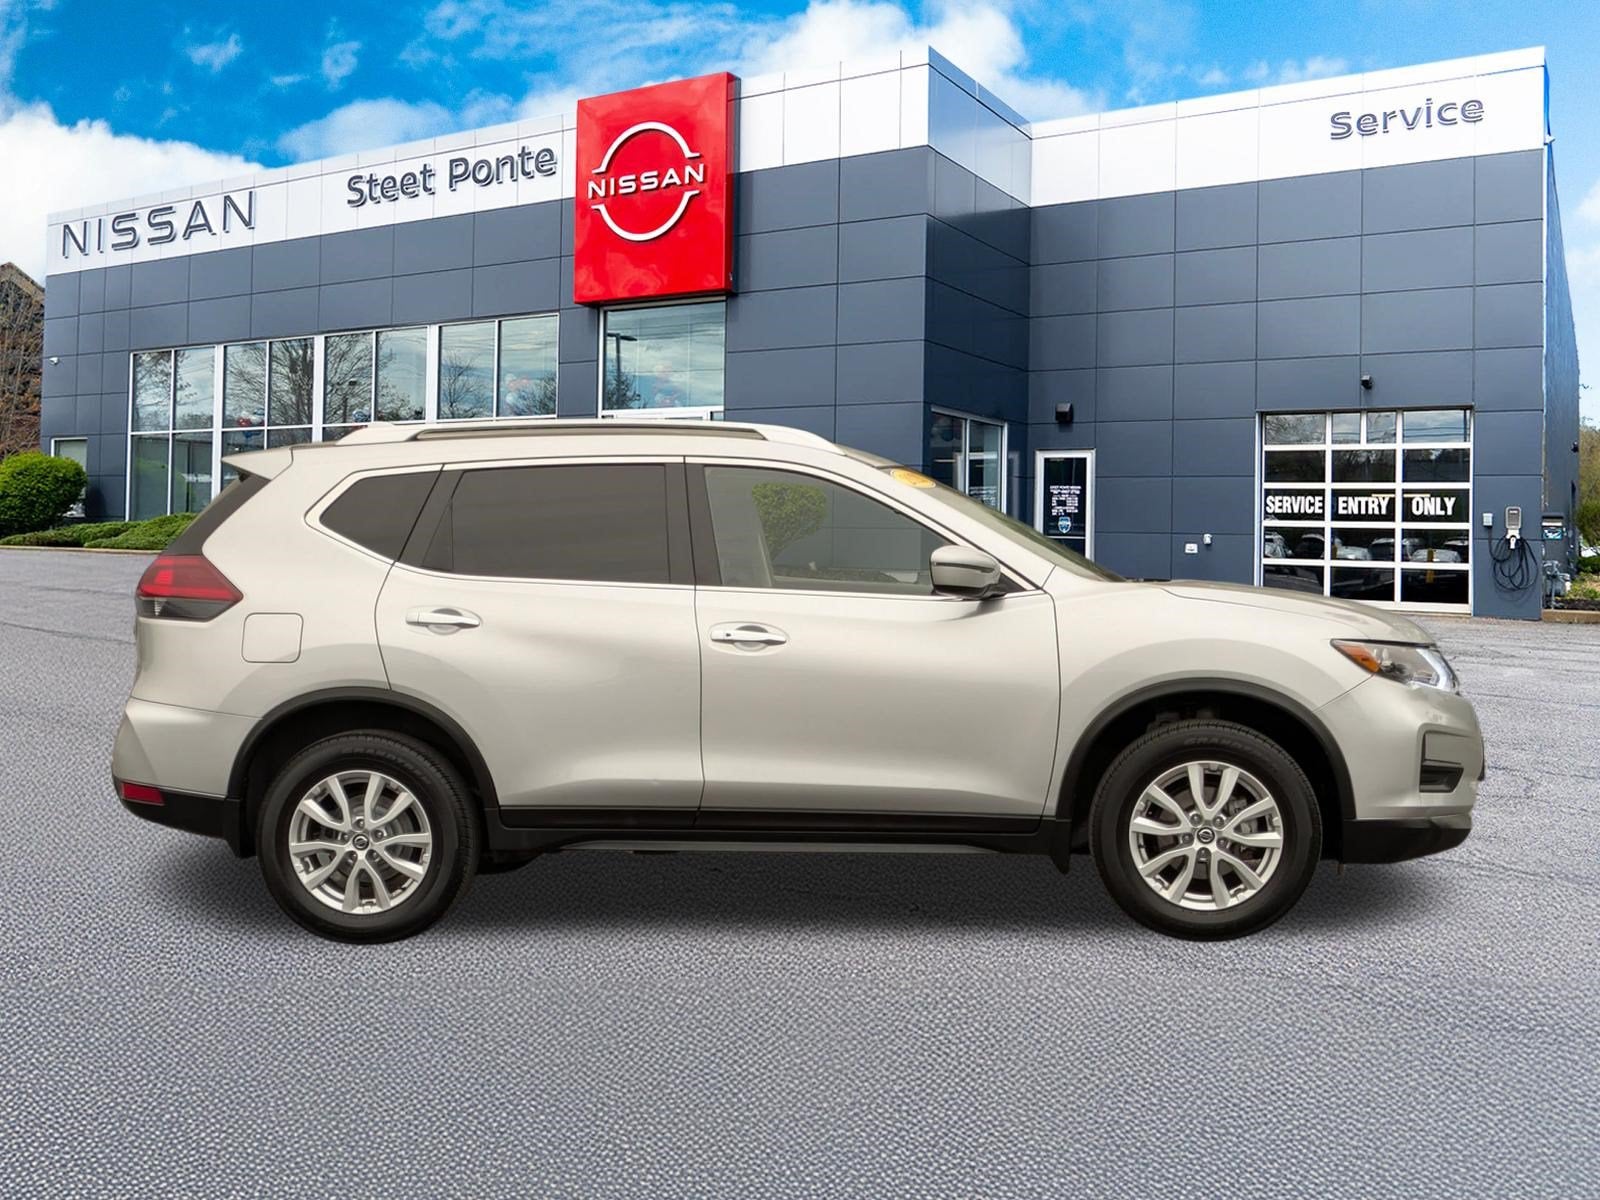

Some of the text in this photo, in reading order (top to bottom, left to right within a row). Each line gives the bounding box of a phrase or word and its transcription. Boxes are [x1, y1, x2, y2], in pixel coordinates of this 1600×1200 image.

[1330, 98, 1484, 140] Service
[347, 146, 557, 207] Steet Ponte
[587, 163, 705, 200] NISSAN
[62, 191, 256, 259] NISSAN
[1265, 495, 1457, 515] SERVICE ENTRY ONLY
